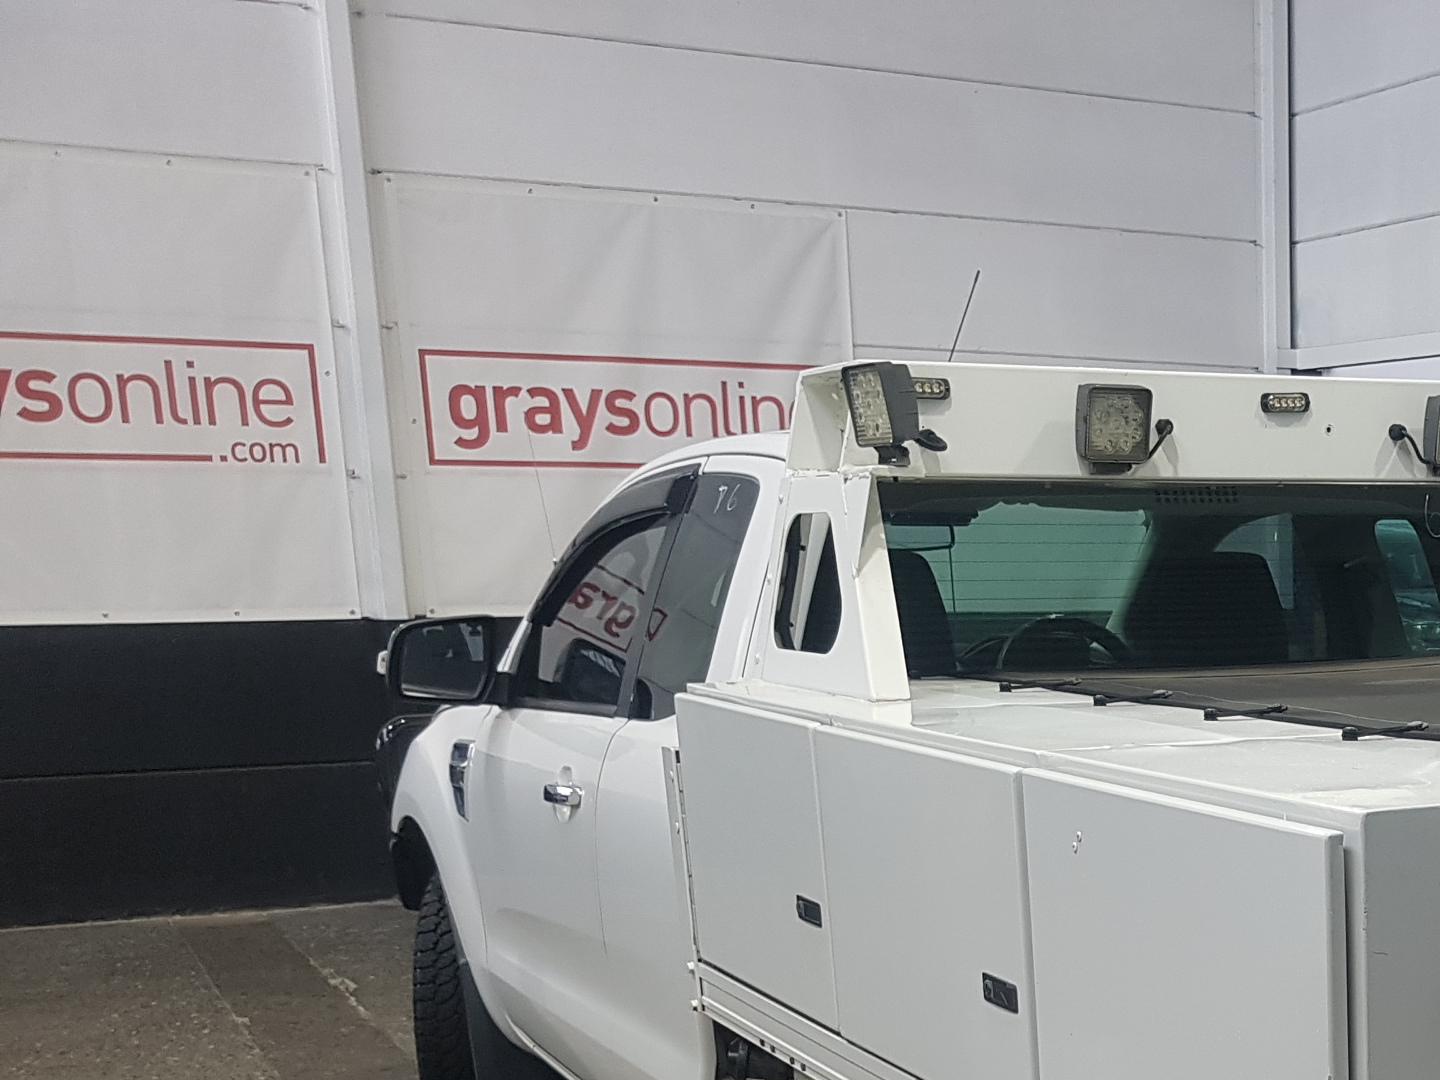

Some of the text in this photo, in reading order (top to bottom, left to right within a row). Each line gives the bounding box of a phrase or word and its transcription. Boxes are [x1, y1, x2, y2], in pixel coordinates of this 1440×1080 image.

[0, 359, 295, 428] sonline
[448, 379, 798, 452] graysonlin
[219, 441, 301, 464] .com
